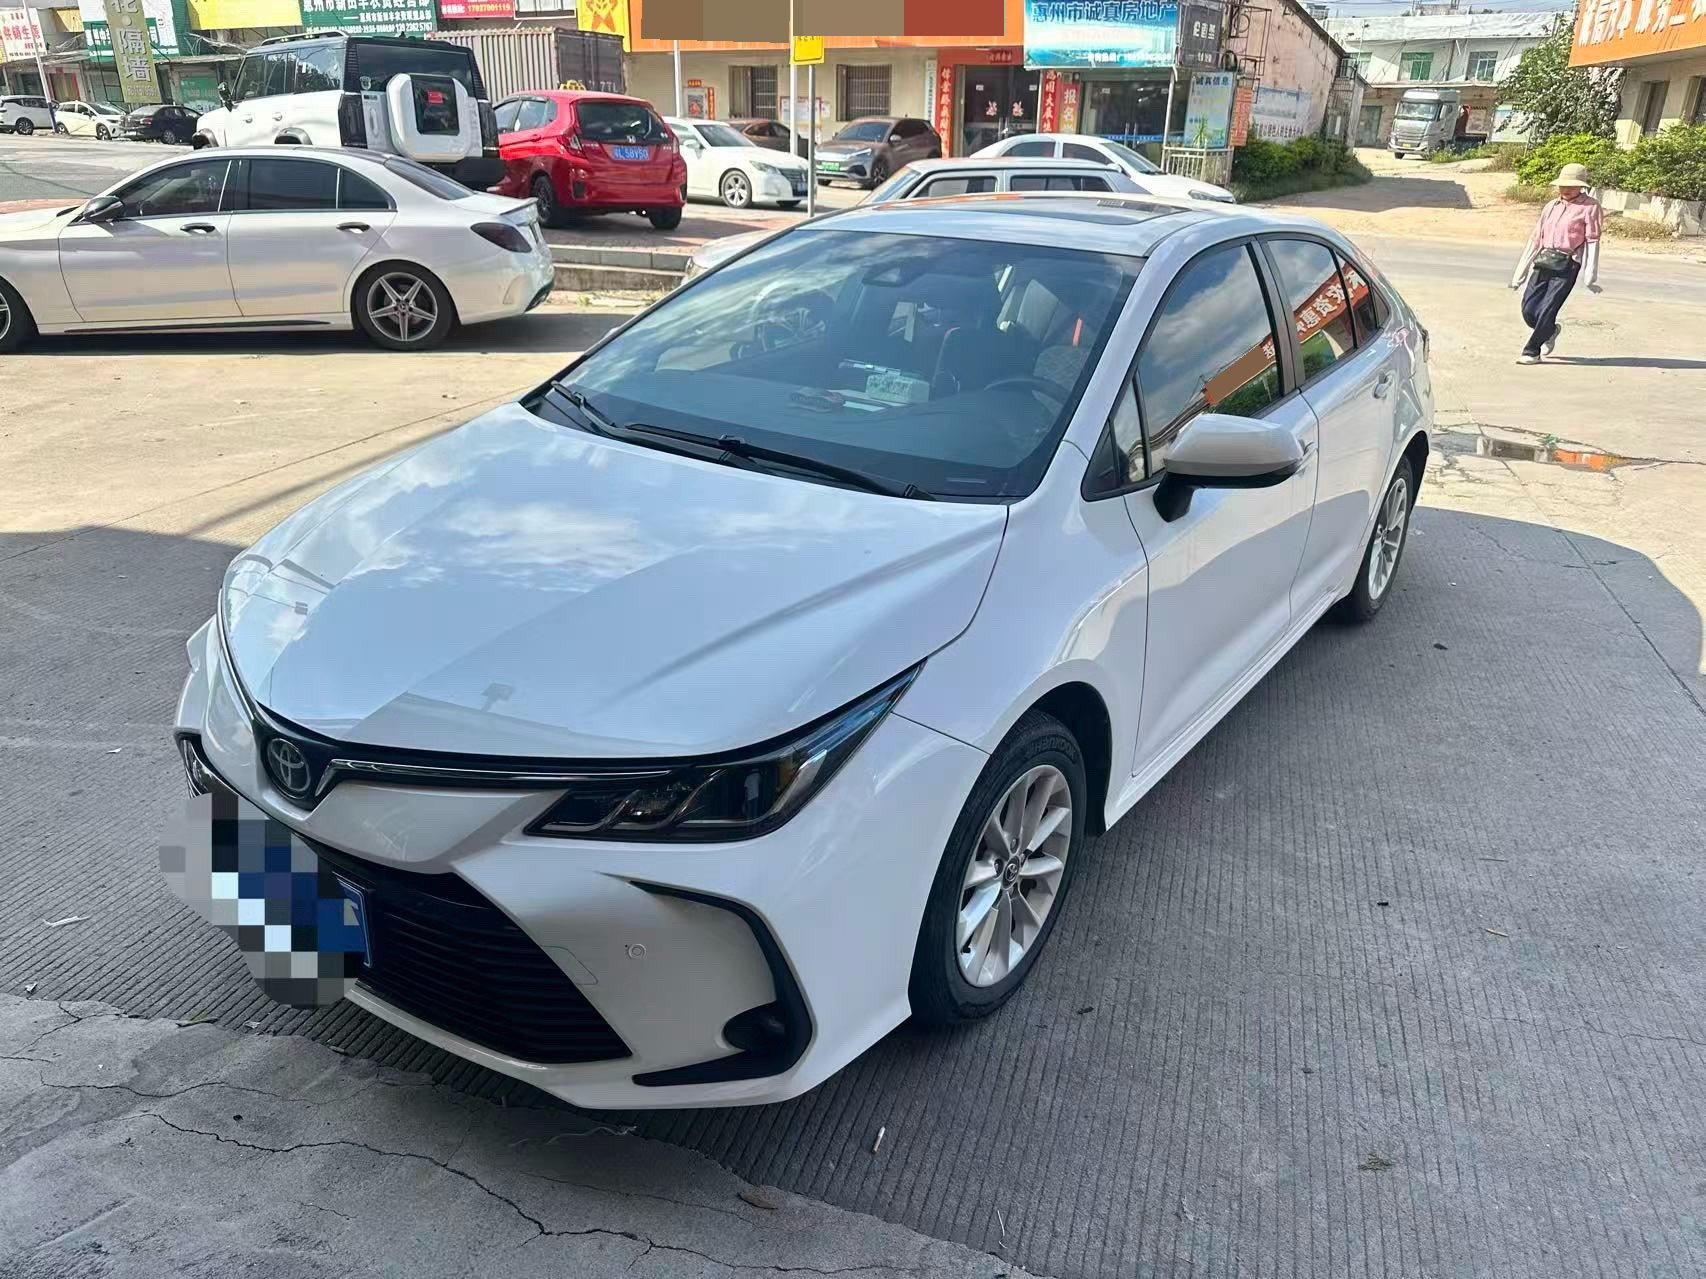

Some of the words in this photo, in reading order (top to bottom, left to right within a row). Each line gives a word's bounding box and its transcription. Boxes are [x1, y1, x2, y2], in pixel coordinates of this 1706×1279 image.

[1032, 1, 1177, 23] 惠州市诚真房地产
